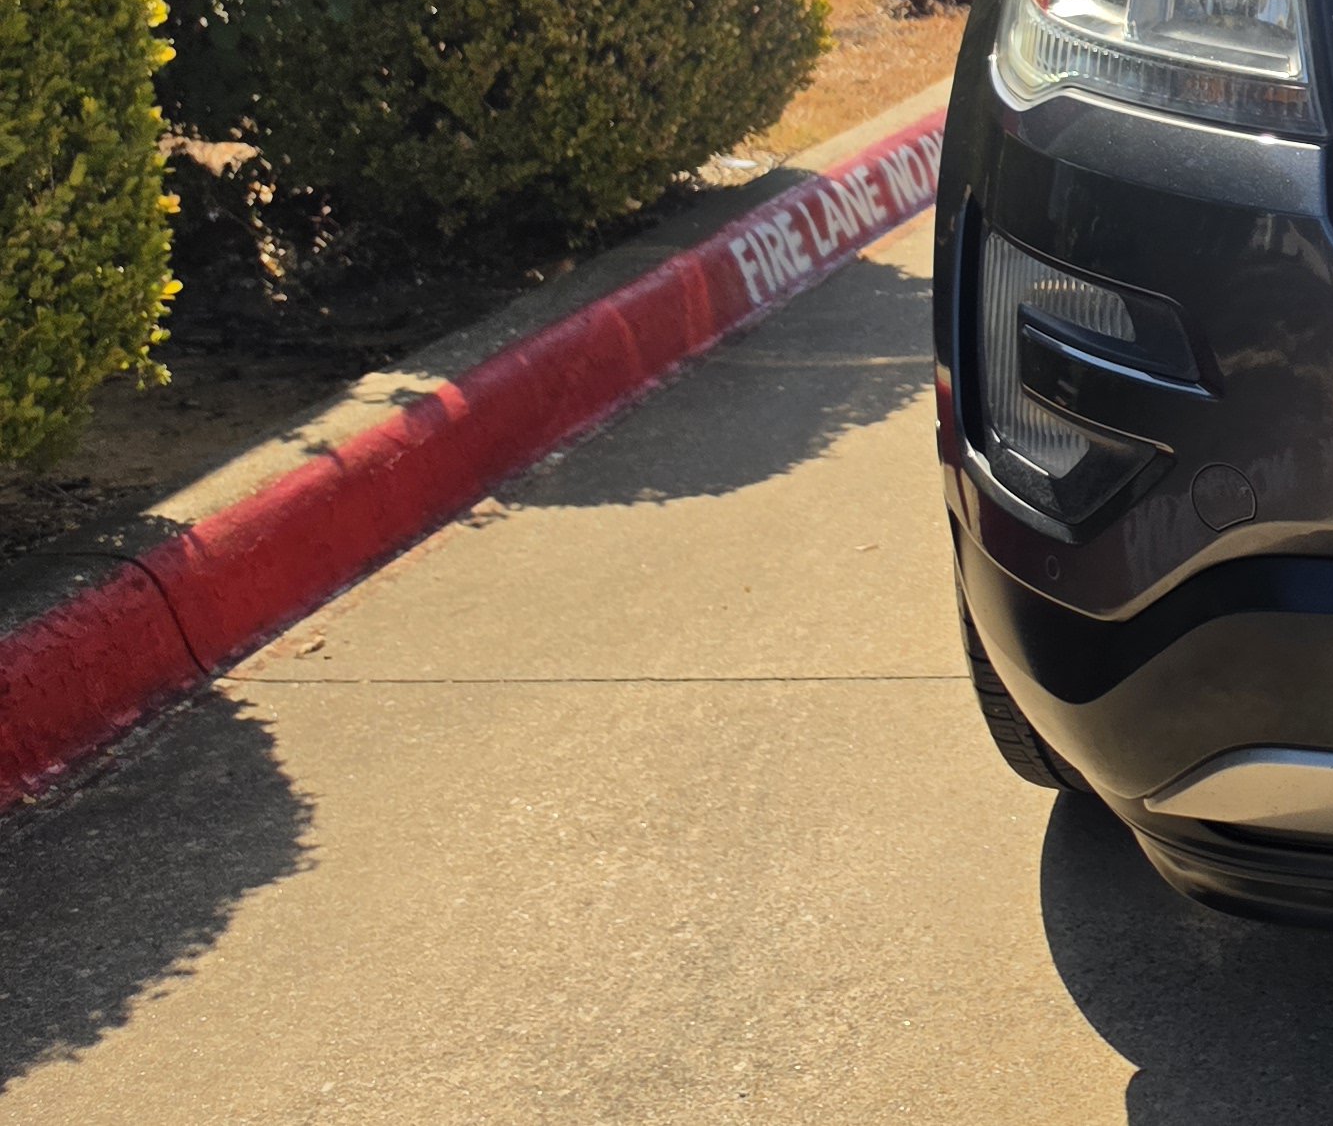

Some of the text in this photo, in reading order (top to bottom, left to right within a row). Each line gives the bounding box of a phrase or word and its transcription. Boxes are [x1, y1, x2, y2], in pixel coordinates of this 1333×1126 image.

[729, 211, 815, 304] FIRE
[799, 165, 888, 257] LANE
[878, 145, 931, 213] NO
